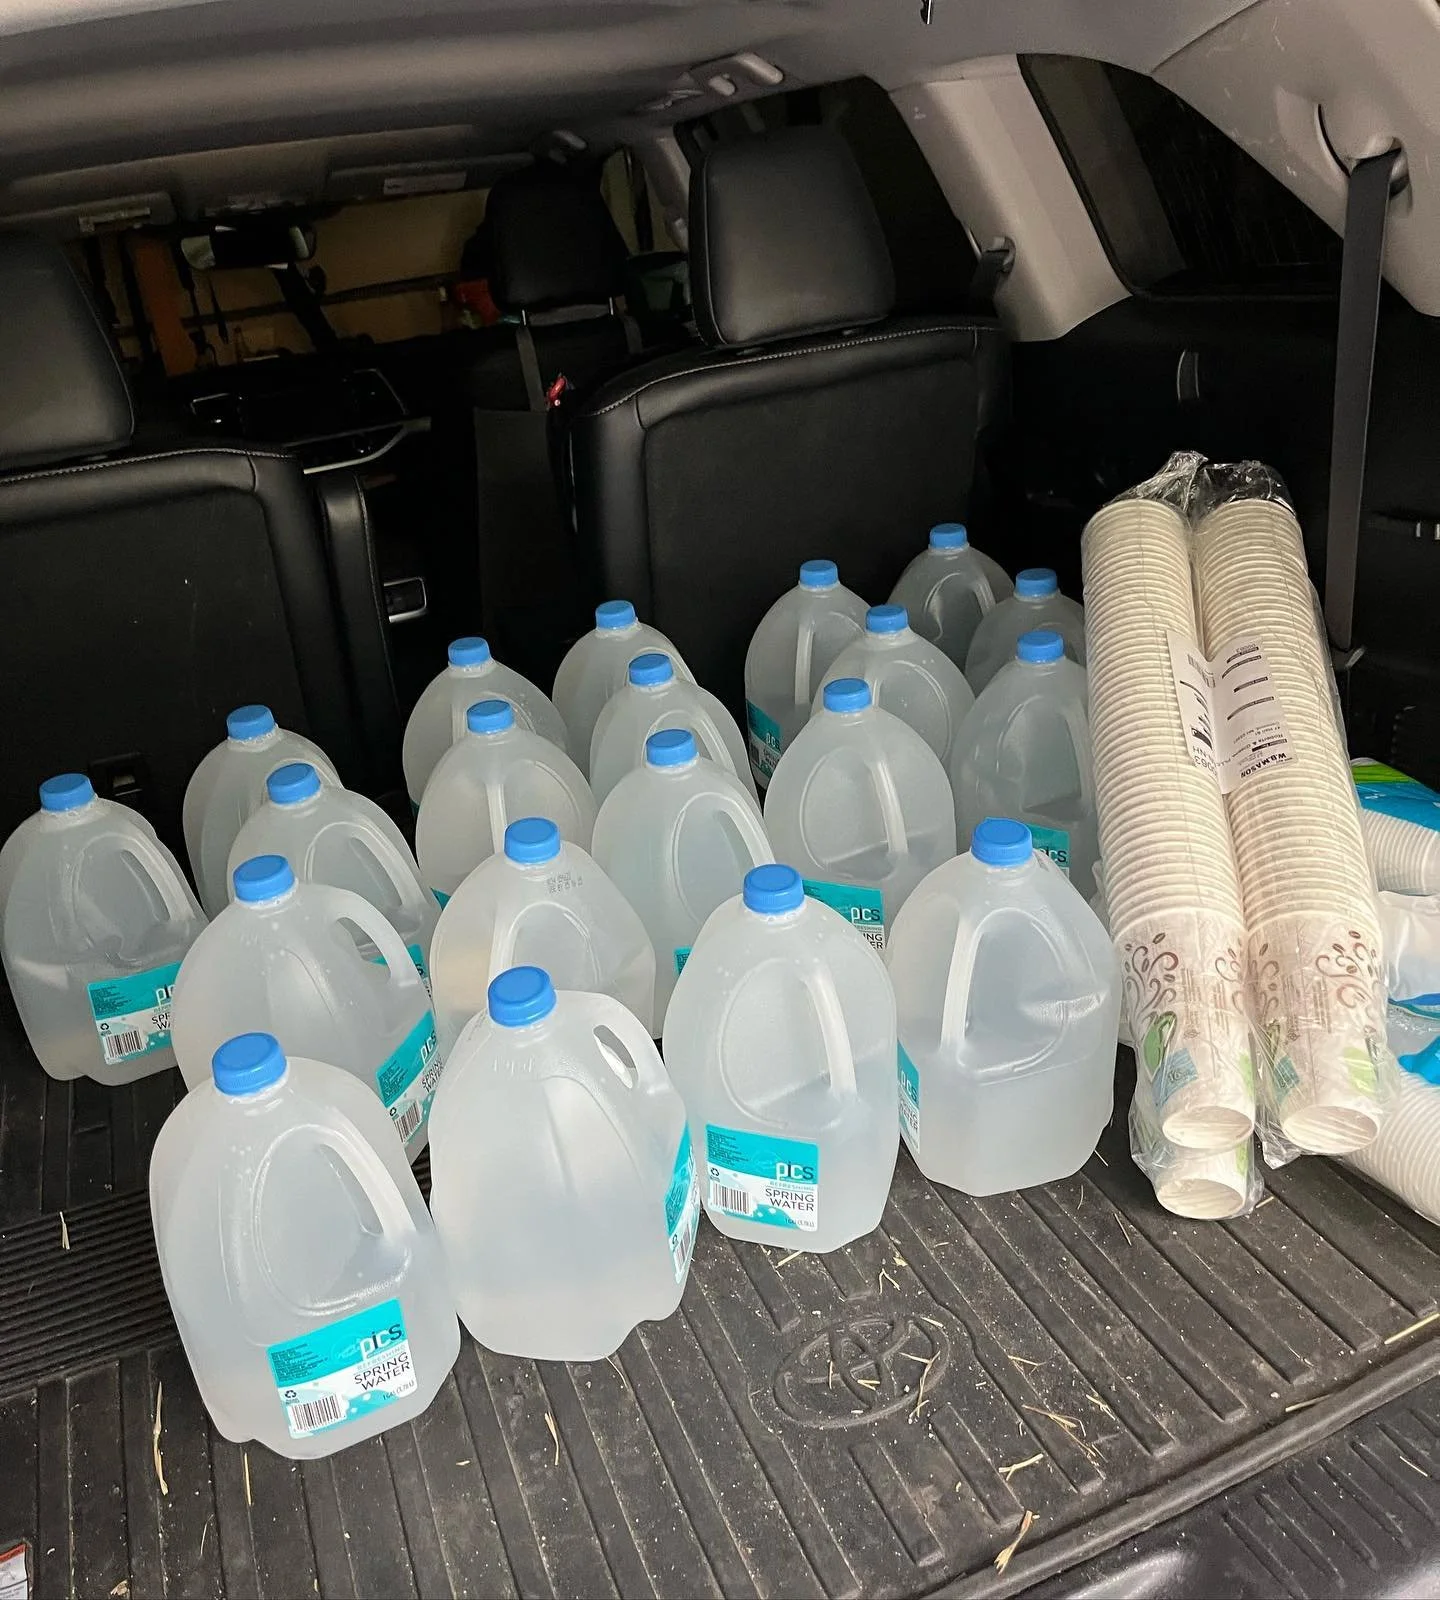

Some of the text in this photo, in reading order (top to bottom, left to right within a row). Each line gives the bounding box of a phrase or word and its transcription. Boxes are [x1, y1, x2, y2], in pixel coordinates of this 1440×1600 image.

[851, 904, 881, 924] pics
[776, 1160, 814, 1181] pics
[765, 1188, 815, 1203] SPRING
[769, 1197, 815, 1212] WATER
[359, 1323, 403, 1361] pics
[354, 1351, 409, 1385] SPRING
[361, 1361, 411, 1391] WATER
